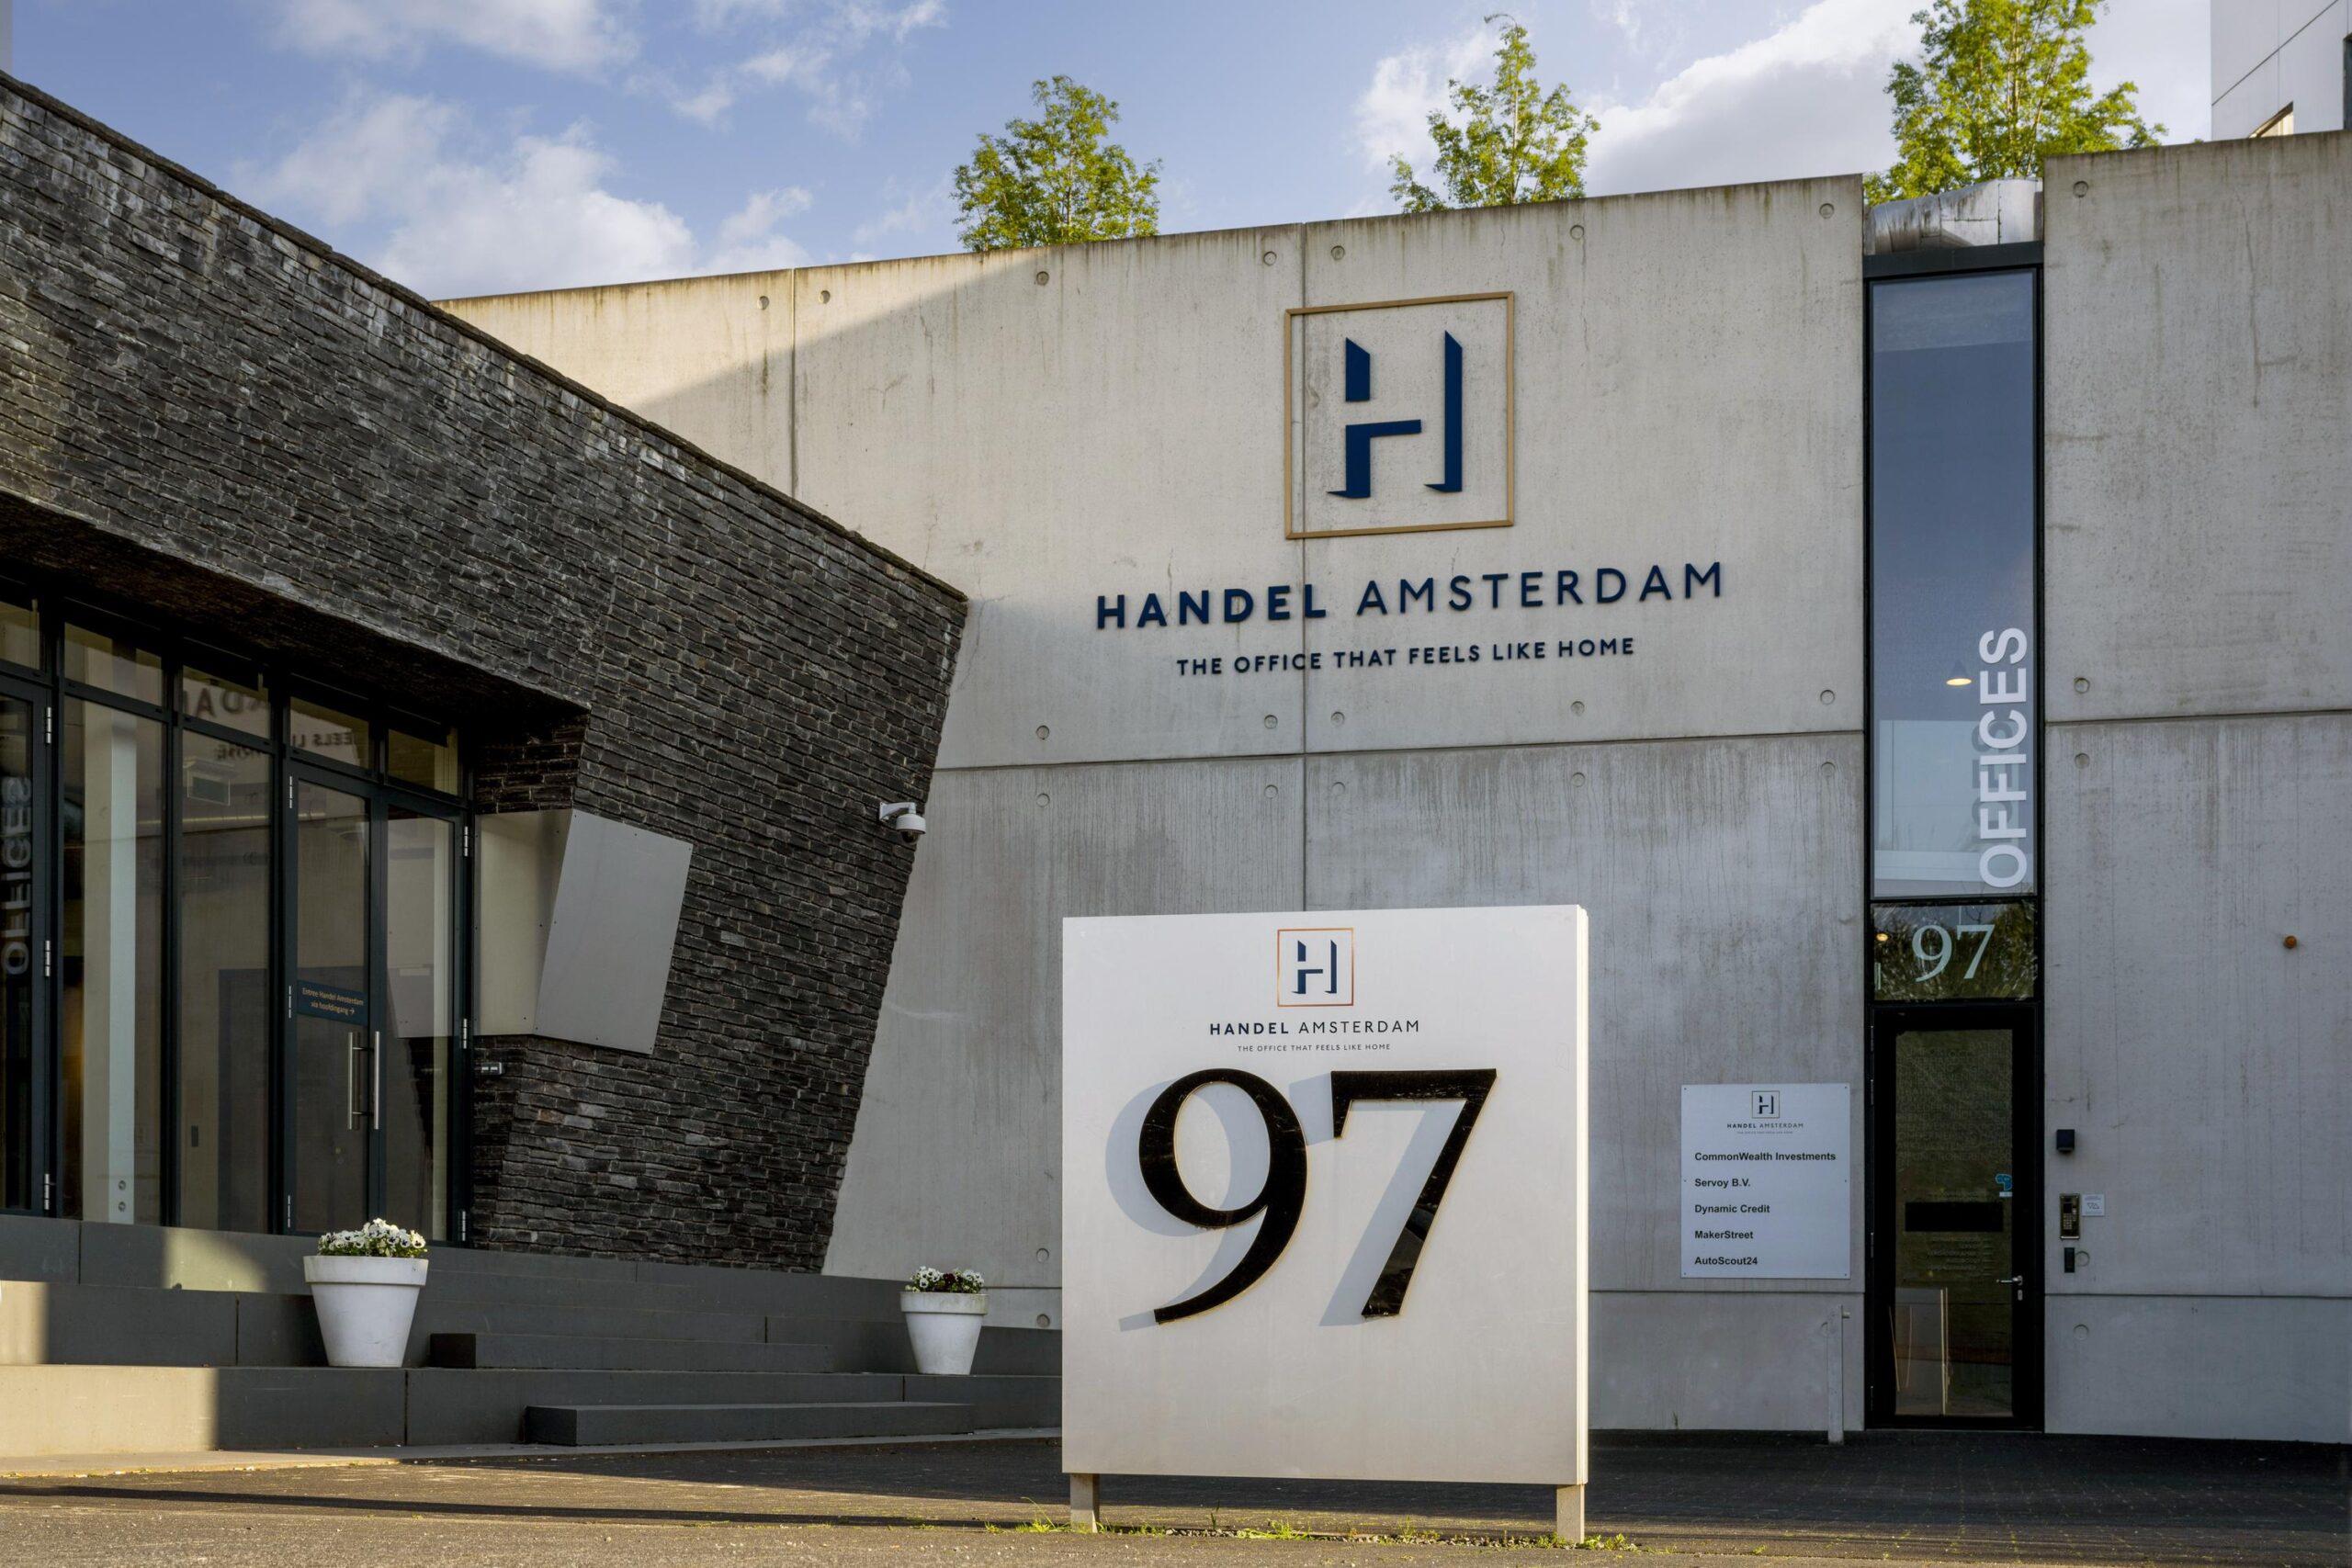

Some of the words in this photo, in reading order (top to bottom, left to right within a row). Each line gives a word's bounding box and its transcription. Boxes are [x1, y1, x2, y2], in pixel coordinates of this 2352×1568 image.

[1097, 583, 1327, 629] HANDEL
[1356, 561, 1721, 616] AMSTERDAM
[1177, 659, 1223, 676] THE
[1234, 652, 1321, 673] OFFICE
[1334, 649, 1397, 669] THAT
[1408, 644, 1481, 665] FEELS
[1493, 641, 1546, 661] LIKE
[1559, 637, 1634, 659] HOME
[1978, 626, 2028, 889] OFFICES
[1912, 924, 1995, 983] 97
[319, 991, 337, 1000] Handel
[336, 995, 364, 1006] Amsterdam
[1209, 1021, 1289, 1036] HANDEL
[1298, 1020, 1419, 1034] AMSTERDAM
[1237, 1044, 1254, 1053] THE
[1256, 1044, 1288, 1053] OFFICE
[1315, 1043, 1340, 1052] FEELS
[1694, 1152, 1773, 1161] CommonWealth
[1775, 1152, 1837, 1161] Investments
[1694, 1178, 1729, 1189] Servoy
[1731, 1178, 1751, 1188] B.V.
[1138, 1068, 1497, 1325] 97
[1694, 1203, 1737, 1214] Dynamic
[1740, 1203, 1770, 1213] Credit
[1694, 1230, 1754, 1240] MakerStreet
[1694, 1256, 1758, 1266] AutoScout24
